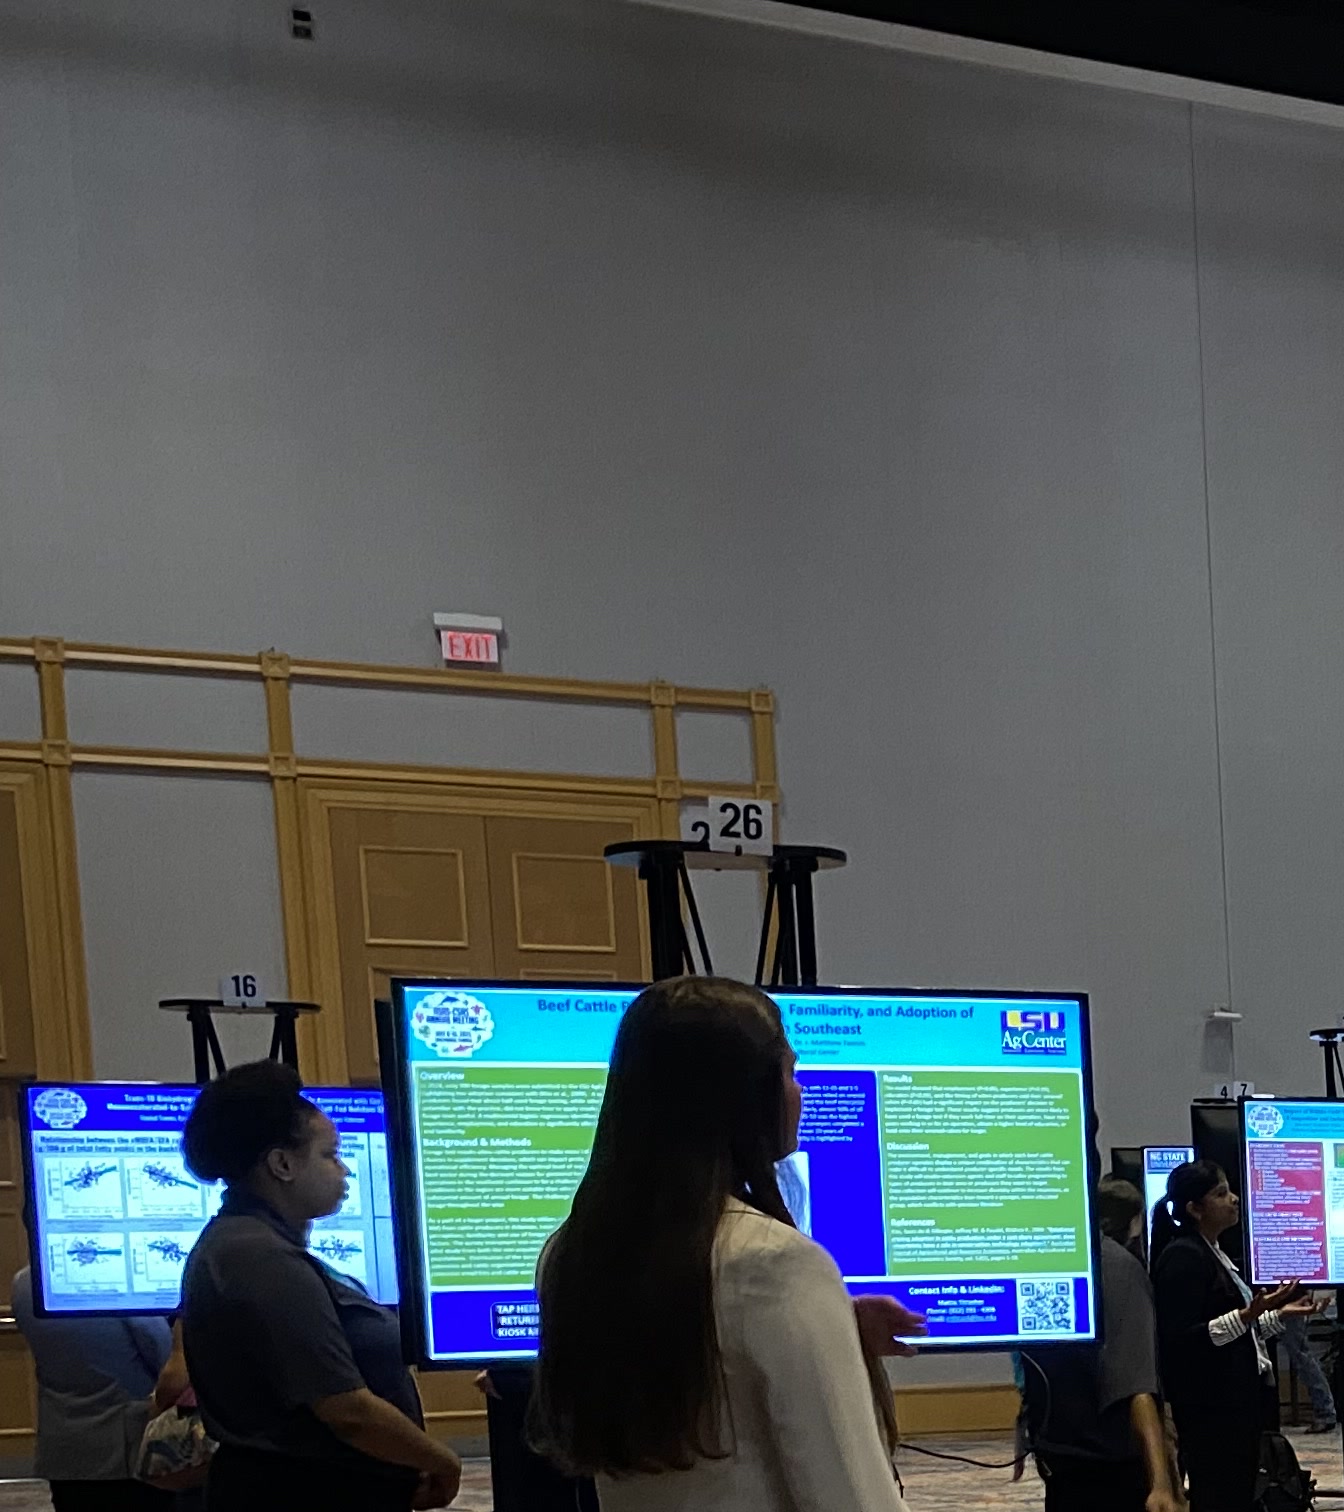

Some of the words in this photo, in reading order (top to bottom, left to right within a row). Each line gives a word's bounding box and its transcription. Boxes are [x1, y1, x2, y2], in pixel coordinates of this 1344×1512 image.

[447, 632, 492, 659] EXIT
[720, 802, 763, 840] 26
[231, 974, 257, 998] 16
[538, 999, 571, 1012] Beef
[575, 999, 617, 1013] Cattle
[789, 1003, 864, 1019] Familiarity,
[867, 1005, 892, 1017] and
[896, 1005, 957, 1020] Adoption
[960, 1006, 974, 1018] of
[794, 1023, 862, 1035] Southeast
[419, 1070, 465, 1081] Overview
[1220, 1086, 1228, 1099] 4
[1240, 1083, 1248, 1096] 7
[423, 1138, 478, 1148] Background
[480, 1138, 488, 1147] &
[490, 1138, 532, 1147] Methods
[1163, 1151, 1185, 1161] STATE
[891, 1218, 936, 1227] References
[909, 1286, 940, 1295] Contact
[497, 1304, 515, 1314] TAP
[498, 1328, 527, 1337] KIOSK
